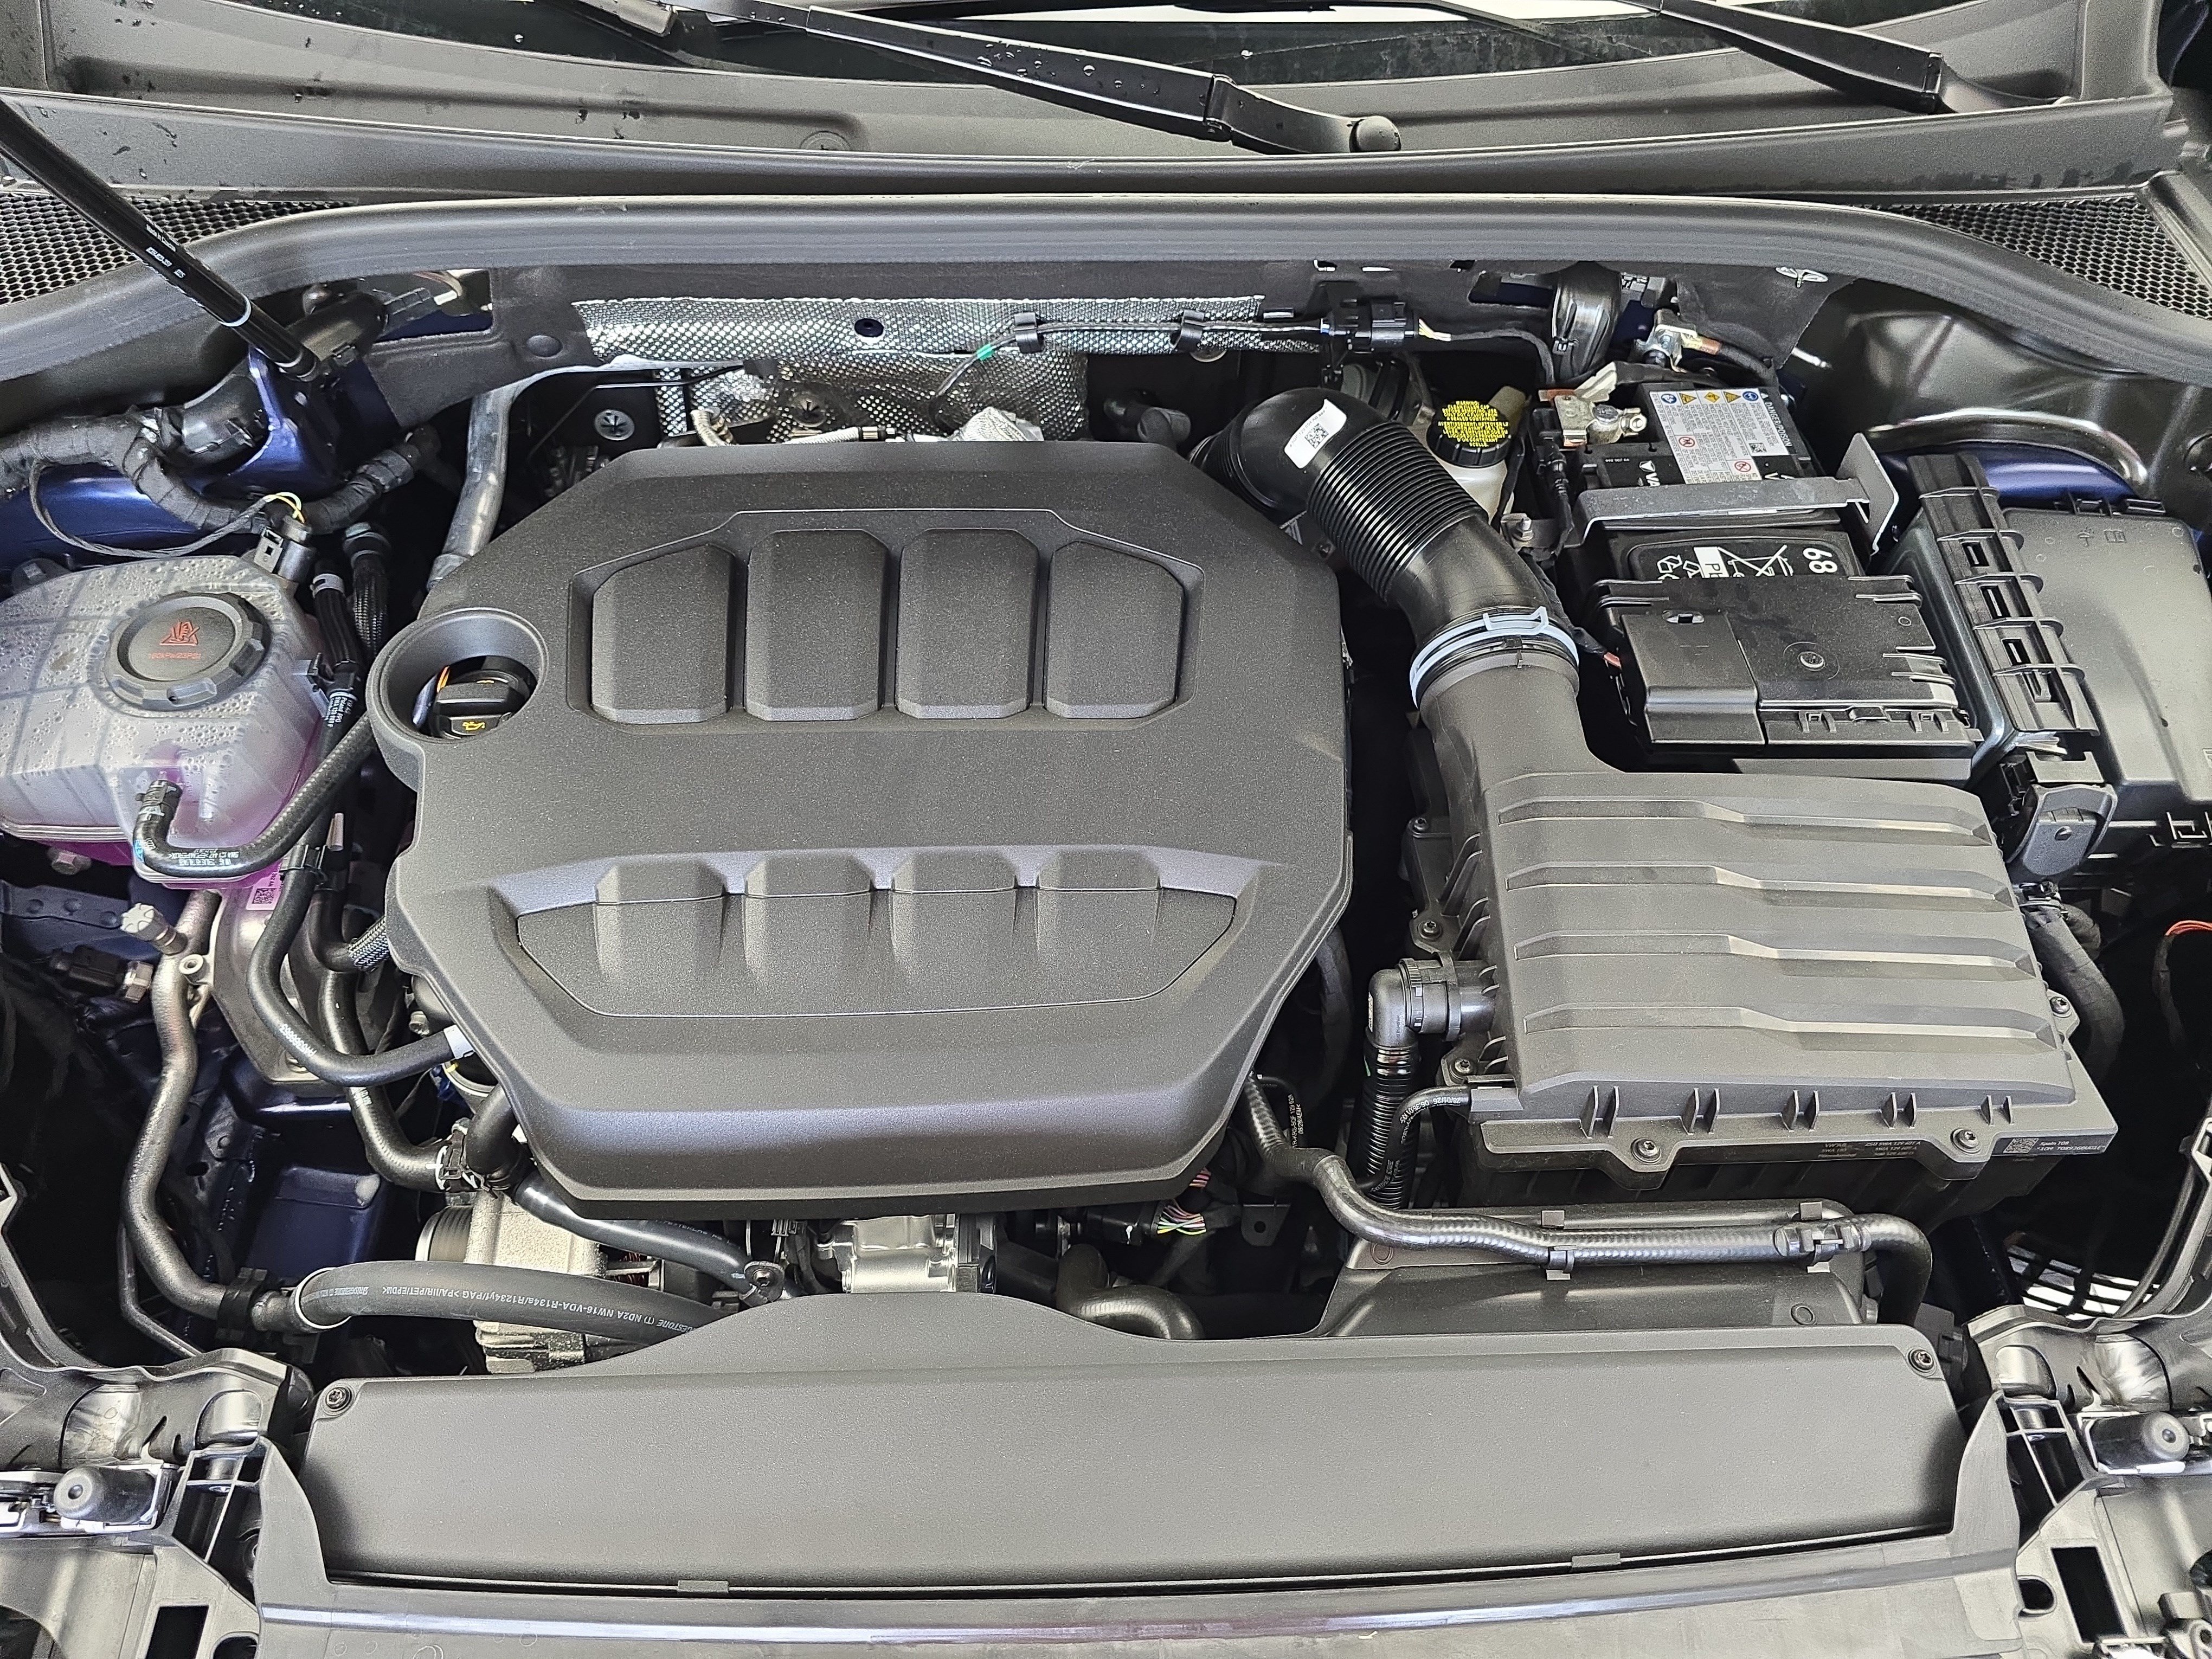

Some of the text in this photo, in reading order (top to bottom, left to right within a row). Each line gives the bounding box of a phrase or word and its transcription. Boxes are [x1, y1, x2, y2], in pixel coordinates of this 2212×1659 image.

[1765, 401, 1792, 447] DANGER/POISON
[1803, 548, 1837, 574] 68
[337, 696, 348, 712] Poland
[616, 1310, 642, 1322] ND2A
[642, 1315, 655, 1324] (T)
